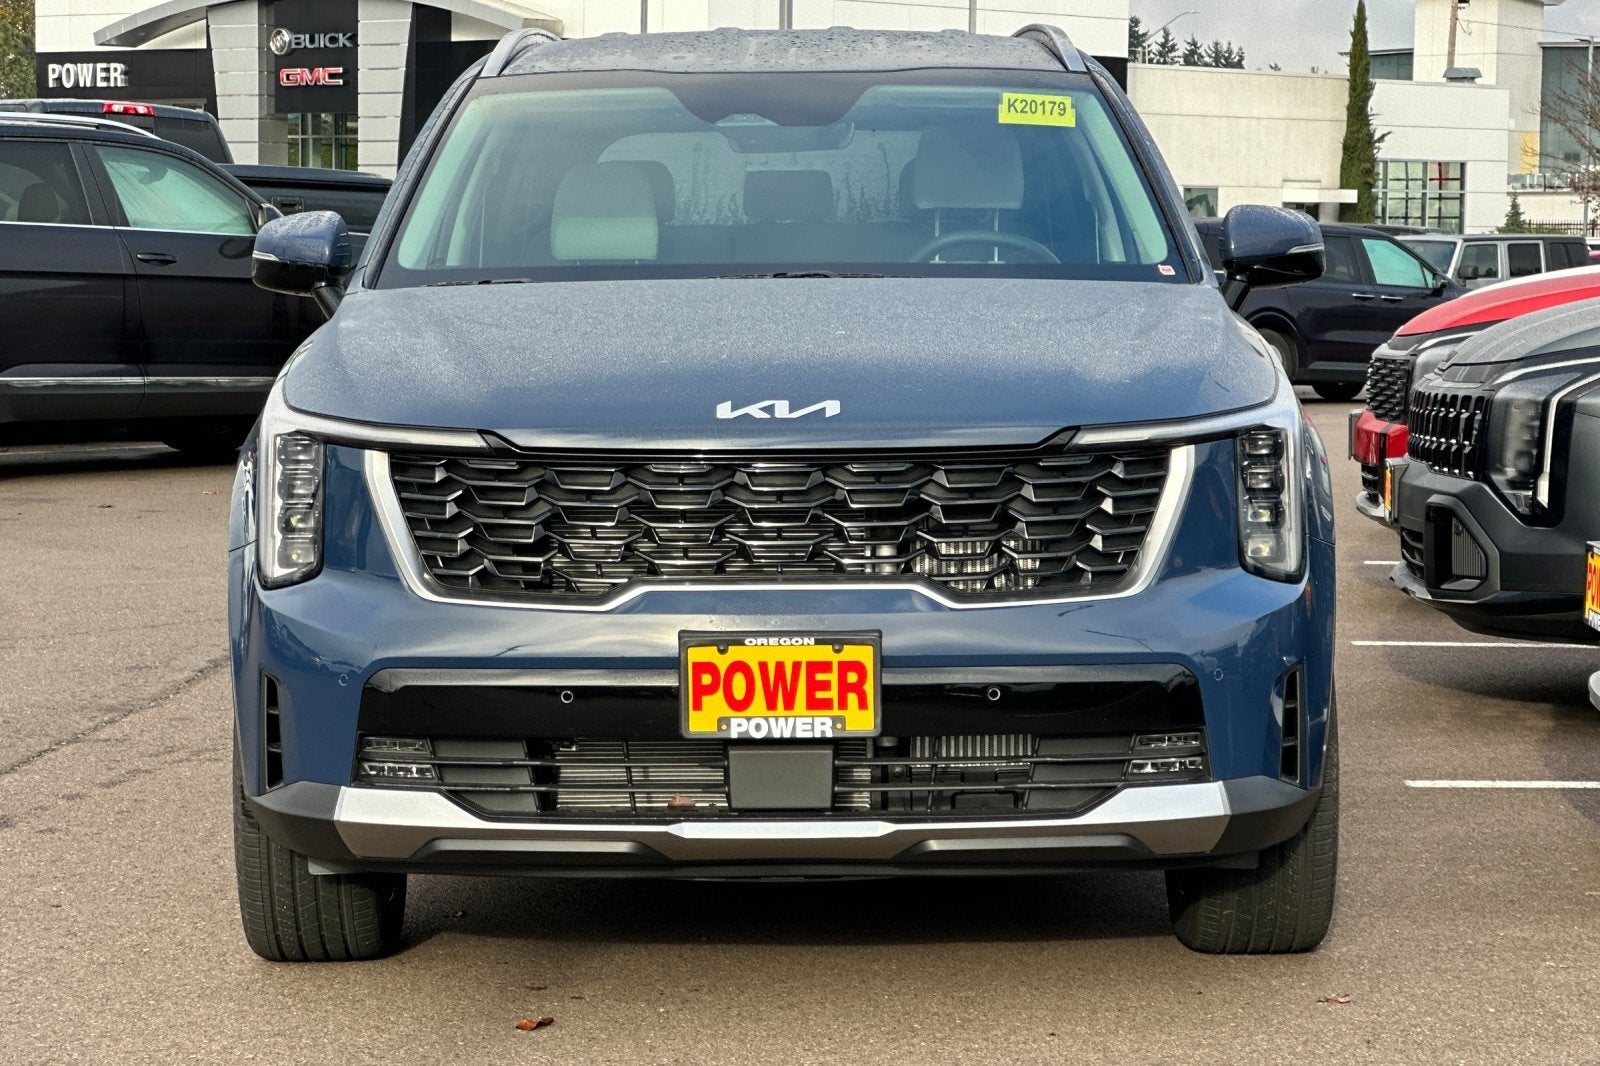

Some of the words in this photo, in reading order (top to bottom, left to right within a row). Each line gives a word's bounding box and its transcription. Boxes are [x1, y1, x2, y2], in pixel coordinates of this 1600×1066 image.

[291, 33, 354, 49] BUICK
[47, 62, 128, 88] POWER
[279, 67, 343, 86] GMC
[1007, 97, 1067, 117] K20179
[744, 637, 815, 646] OREGON
[691, 660, 869, 712] POWER
[730, 716, 833, 739] POWER
